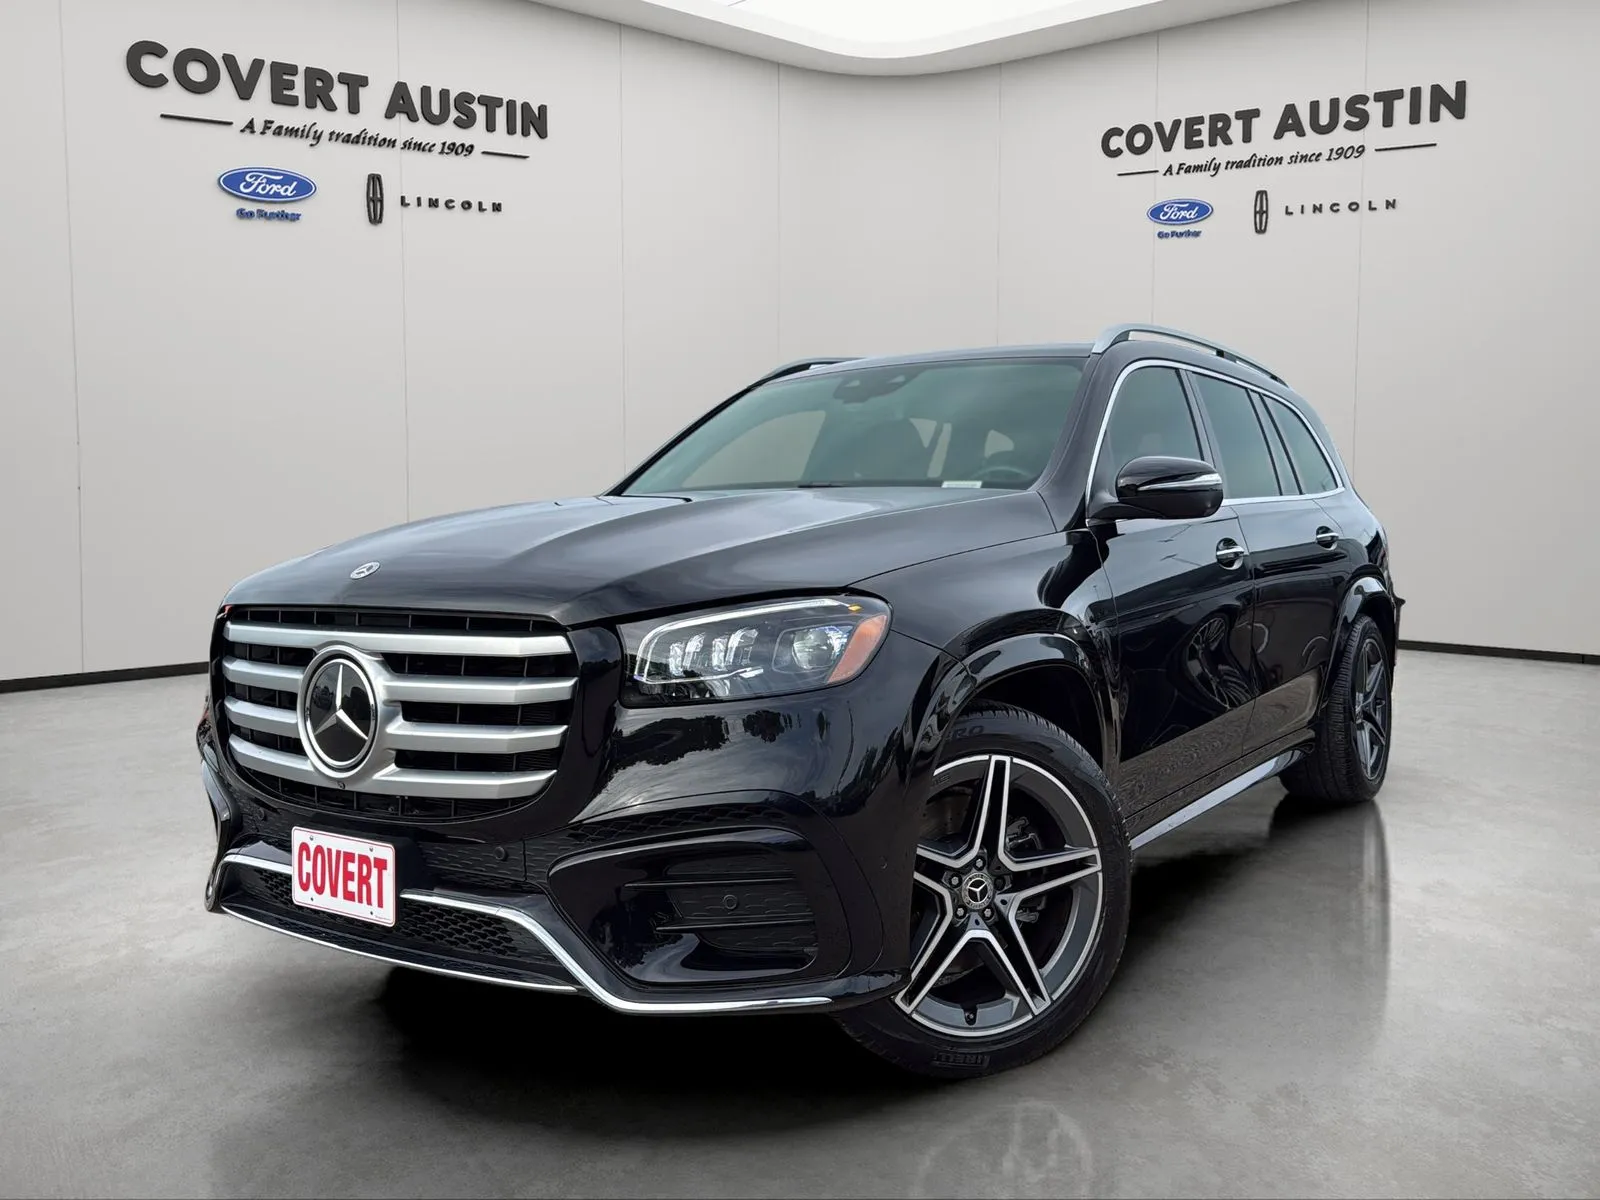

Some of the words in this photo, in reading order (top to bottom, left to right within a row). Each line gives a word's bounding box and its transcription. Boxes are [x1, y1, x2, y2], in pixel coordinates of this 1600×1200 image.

[126, 40, 370, 116] COVERT
[385, 81, 548, 140] AUSTIN
[1100, 108, 1261, 159] COVERT
[1273, 79, 1467, 141] AUSTIN
[239, 118, 257, 135] A
[259, 119, 324, 148] Family
[327, 128, 398, 149] tradition
[400, 139, 437, 154] since
[438, 140, 475, 158] 1909
[1162, 163, 1174, 177] A
[1175, 156, 1222, 178] Family
[1224, 152, 1284, 171] tradition
[1287, 151, 1323, 165] since
[1325, 144, 1366, 162] 1909
[239, 171, 298, 197] Ford
[400, 195, 502, 213] LINCOLN
[1159, 203, 1199, 220] Ford
[1284, 198, 1397, 217] LINCOLN
[298, 841, 388, 909] COVERT
